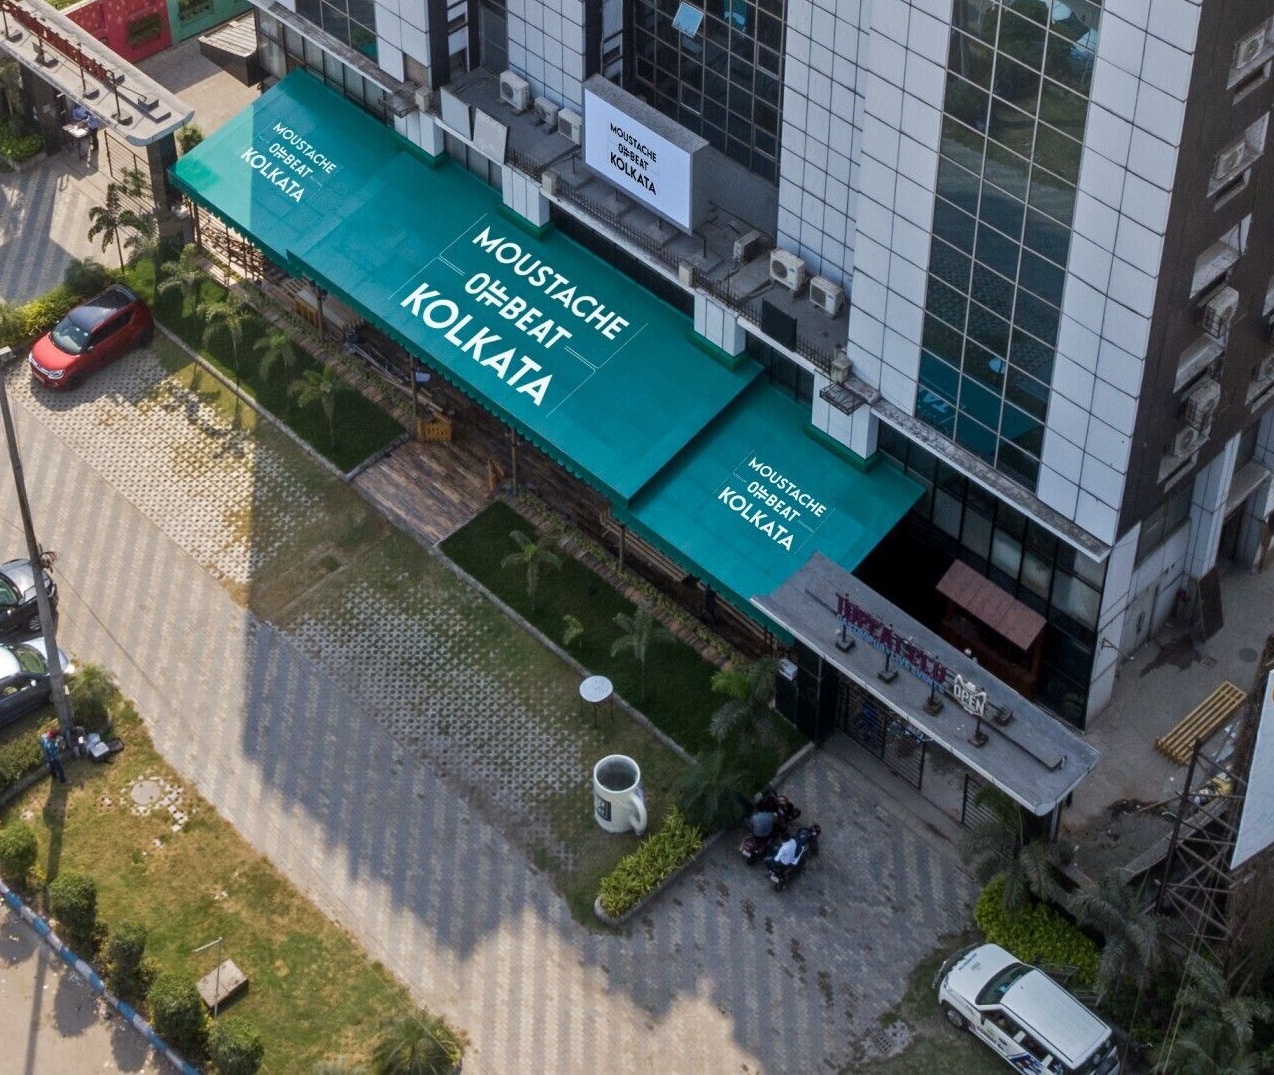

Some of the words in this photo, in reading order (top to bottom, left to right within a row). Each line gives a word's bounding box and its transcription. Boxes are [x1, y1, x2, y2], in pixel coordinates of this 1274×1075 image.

[273, 121, 337, 174] MOUSTACHE
[610, 122, 657, 163] MOUSTACHE
[240, 147, 305, 203] KOLKATA
[610, 151, 657, 196] KOLKATA
[472, 225, 630, 341] MOUSTACHE
[400, 282, 553, 407] KOLKATA
[748, 456, 827, 518] MOUSTACHE
[718, 486, 794, 552] KOLKATA
[953, 684, 985, 714] OPEN
